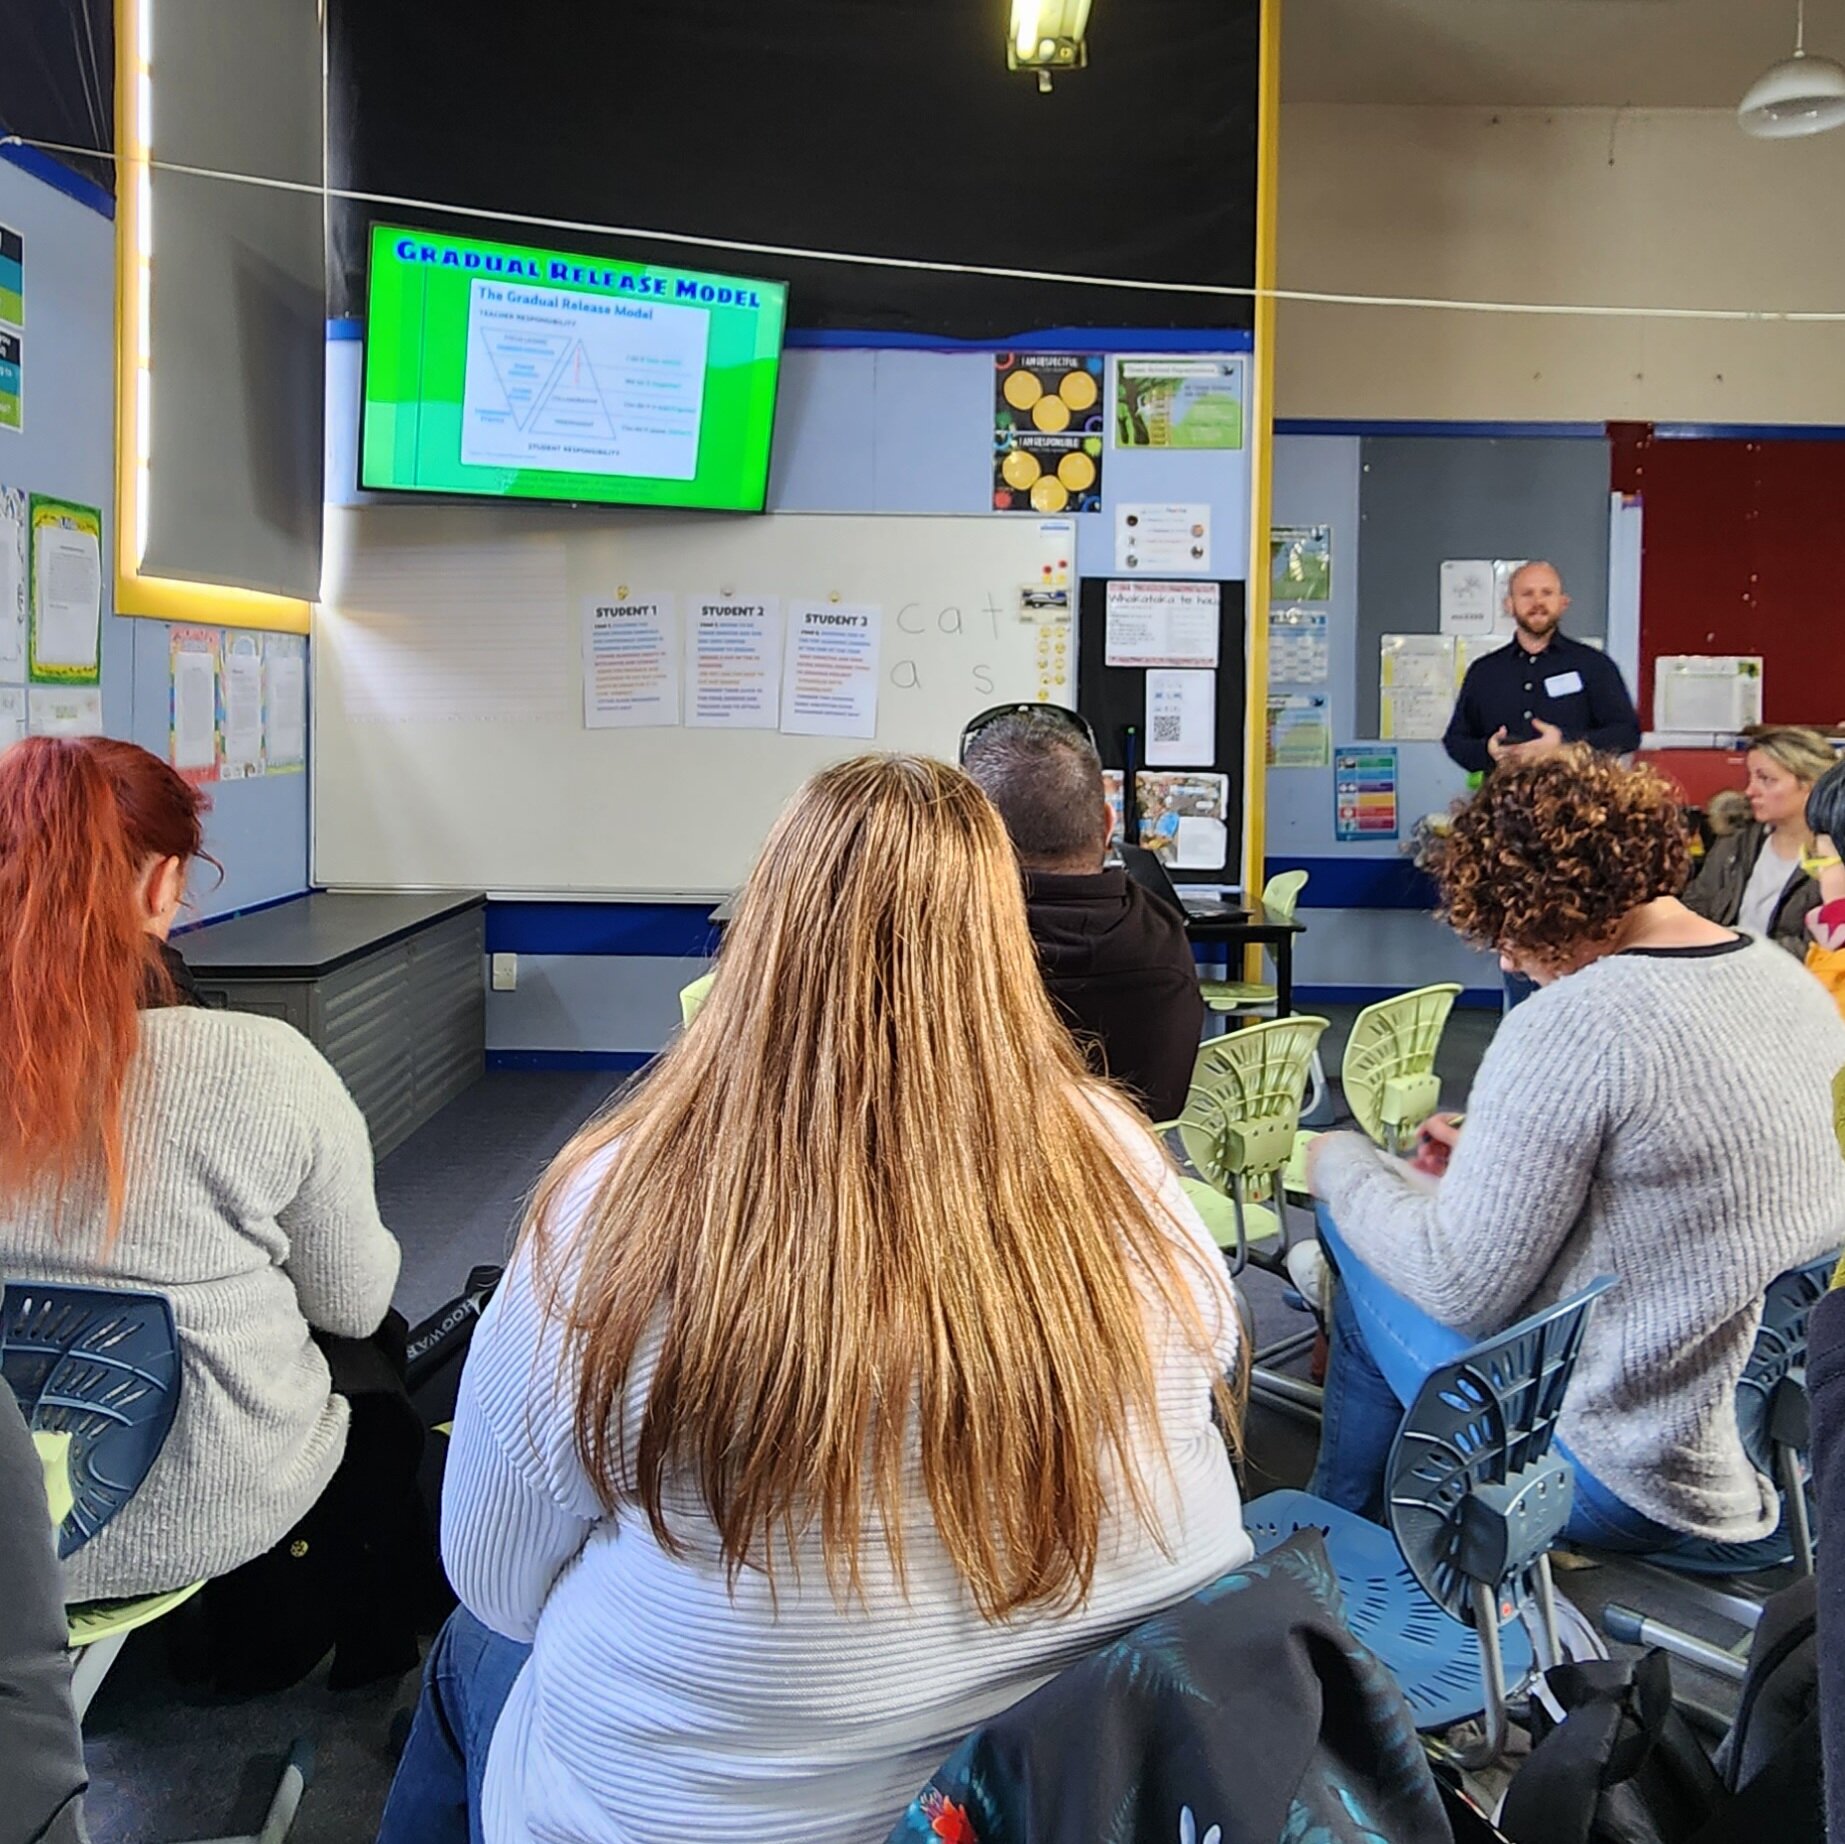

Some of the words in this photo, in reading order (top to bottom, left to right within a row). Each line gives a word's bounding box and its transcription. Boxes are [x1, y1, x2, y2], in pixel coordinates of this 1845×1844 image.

[549, 260, 667, 297] RELEASE
[675, 278, 761, 309] MODEL
[478, 286, 503, 301] The
[507, 290, 558, 309] Gradual
[562, 299, 611, 315] Release
[614, 304, 654, 322] Model
[596, 606, 650, 618] STUDENT
[651, 605, 658, 616] 1
[701, 605, 755, 617] STUDENT
[757, 606, 765, 617] 2
[805, 613, 858, 626] STUDENT
[860, 616, 868, 626] 3
